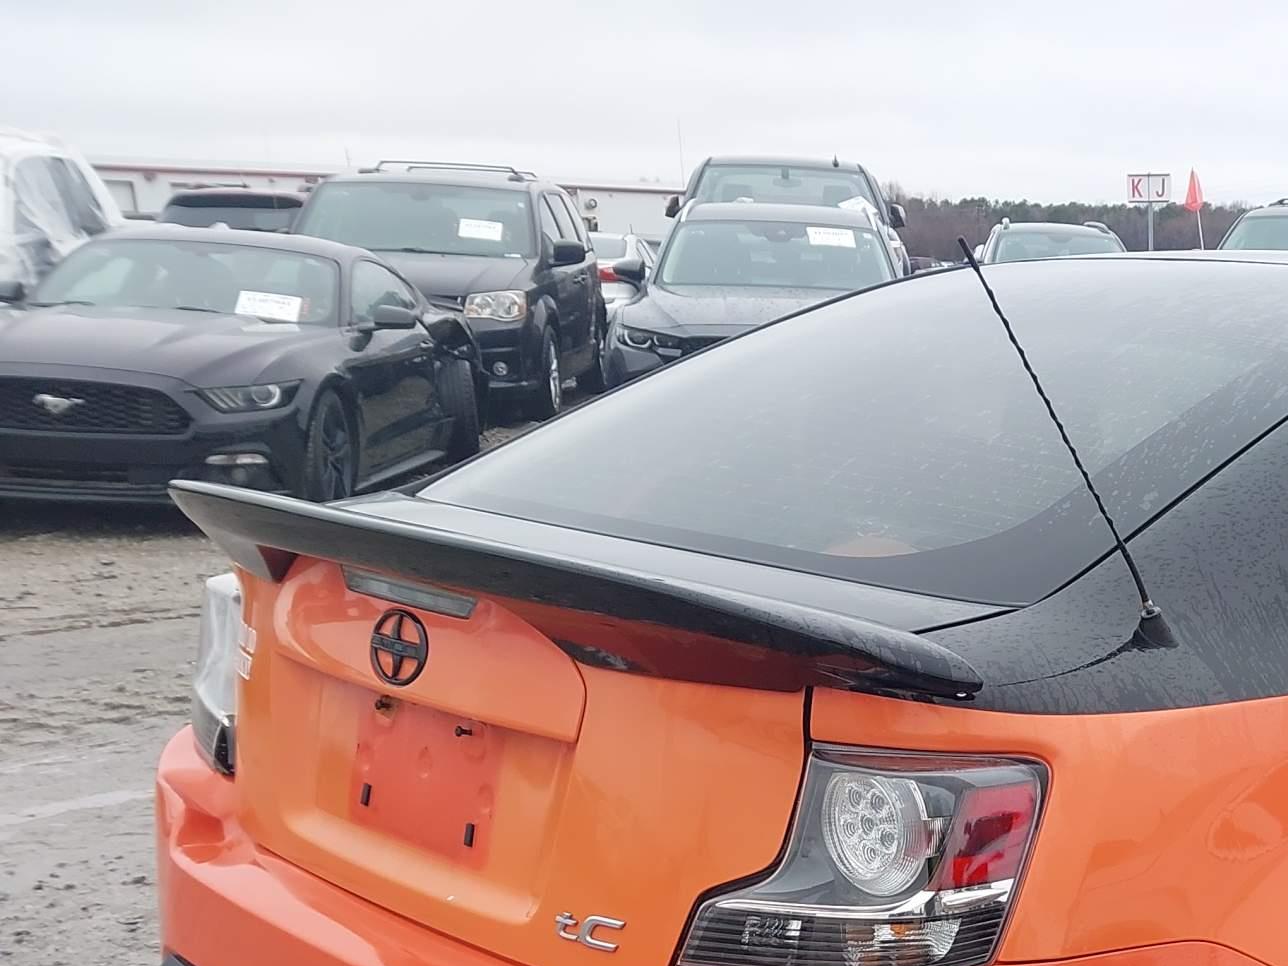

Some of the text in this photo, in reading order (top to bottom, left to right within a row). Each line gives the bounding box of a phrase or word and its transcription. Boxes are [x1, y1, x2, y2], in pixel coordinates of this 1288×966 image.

[1131, 177, 1165, 198] K J
[555, 912, 626, 953] tC
